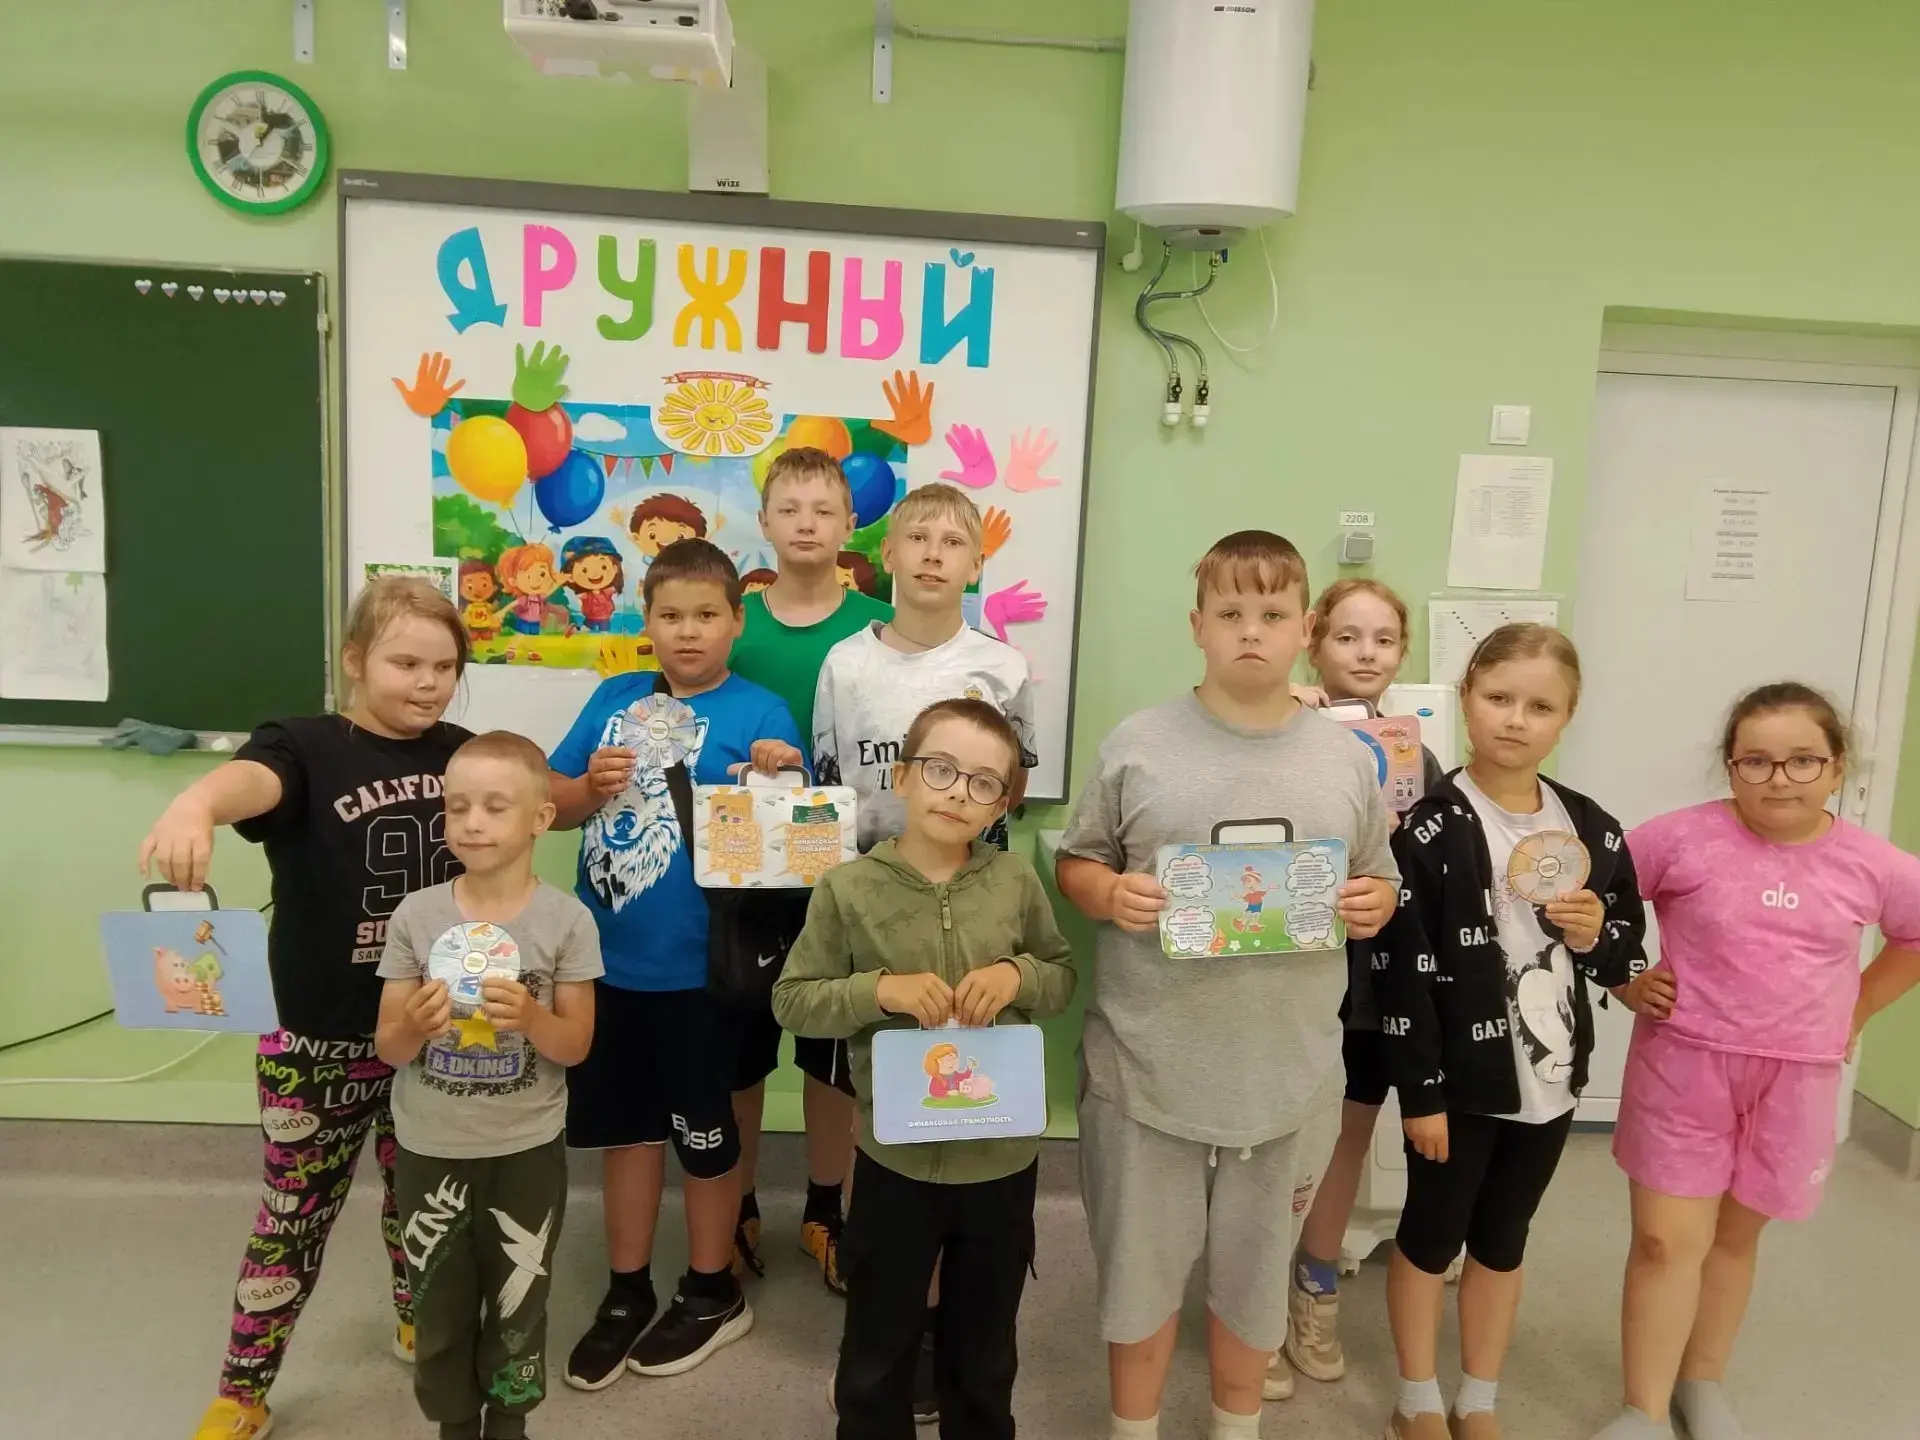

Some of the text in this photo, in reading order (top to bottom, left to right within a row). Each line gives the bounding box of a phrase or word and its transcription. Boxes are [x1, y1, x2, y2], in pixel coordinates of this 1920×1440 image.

[1346, 515, 1368, 523] 2208
[333, 774, 445, 823] CALIFO
[1762, 881, 1799, 909] alo
[1383, 1016, 1411, 1036] GAP
[1472, 1018, 1508, 1041] GAP
